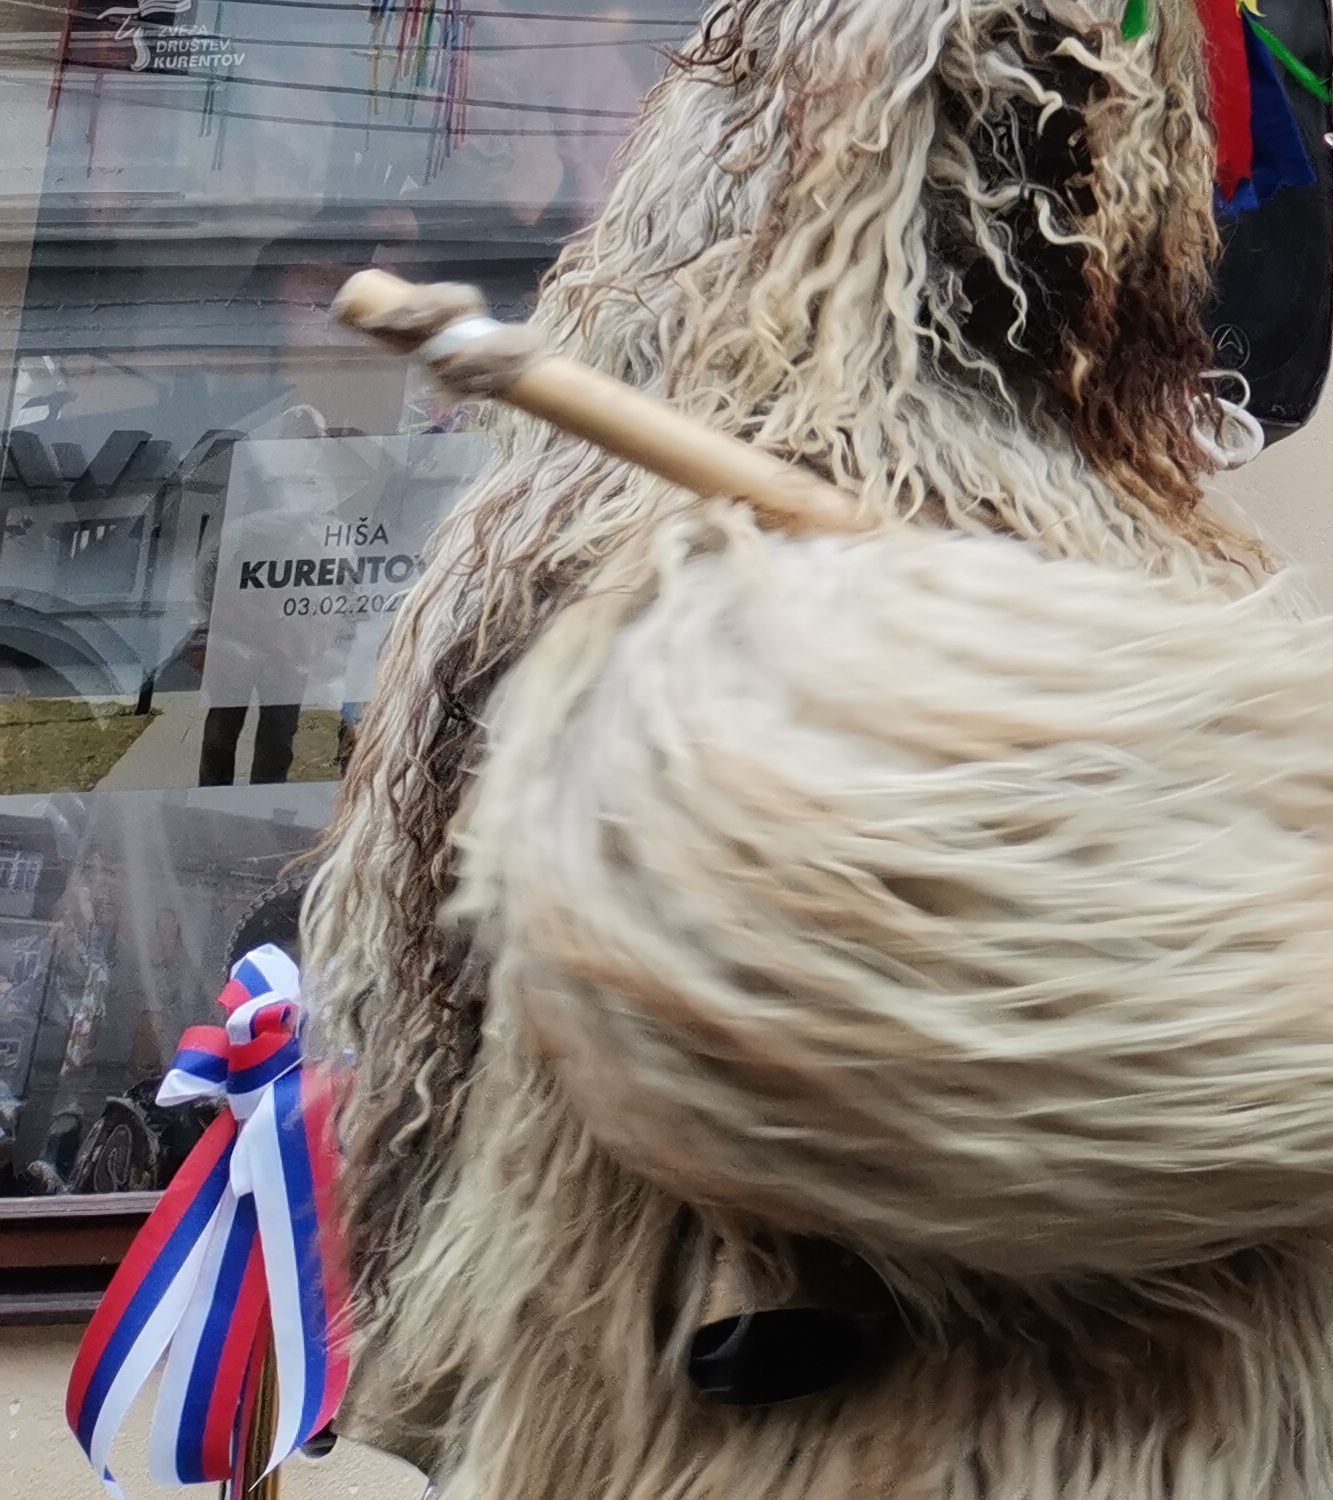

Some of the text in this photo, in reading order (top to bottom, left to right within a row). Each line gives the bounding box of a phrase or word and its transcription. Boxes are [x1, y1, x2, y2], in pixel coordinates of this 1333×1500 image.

[153, 53, 246, 68] KURENTOV
[324, 516, 389, 547] HIŠA
[283, 594, 403, 616] 03.02.202
